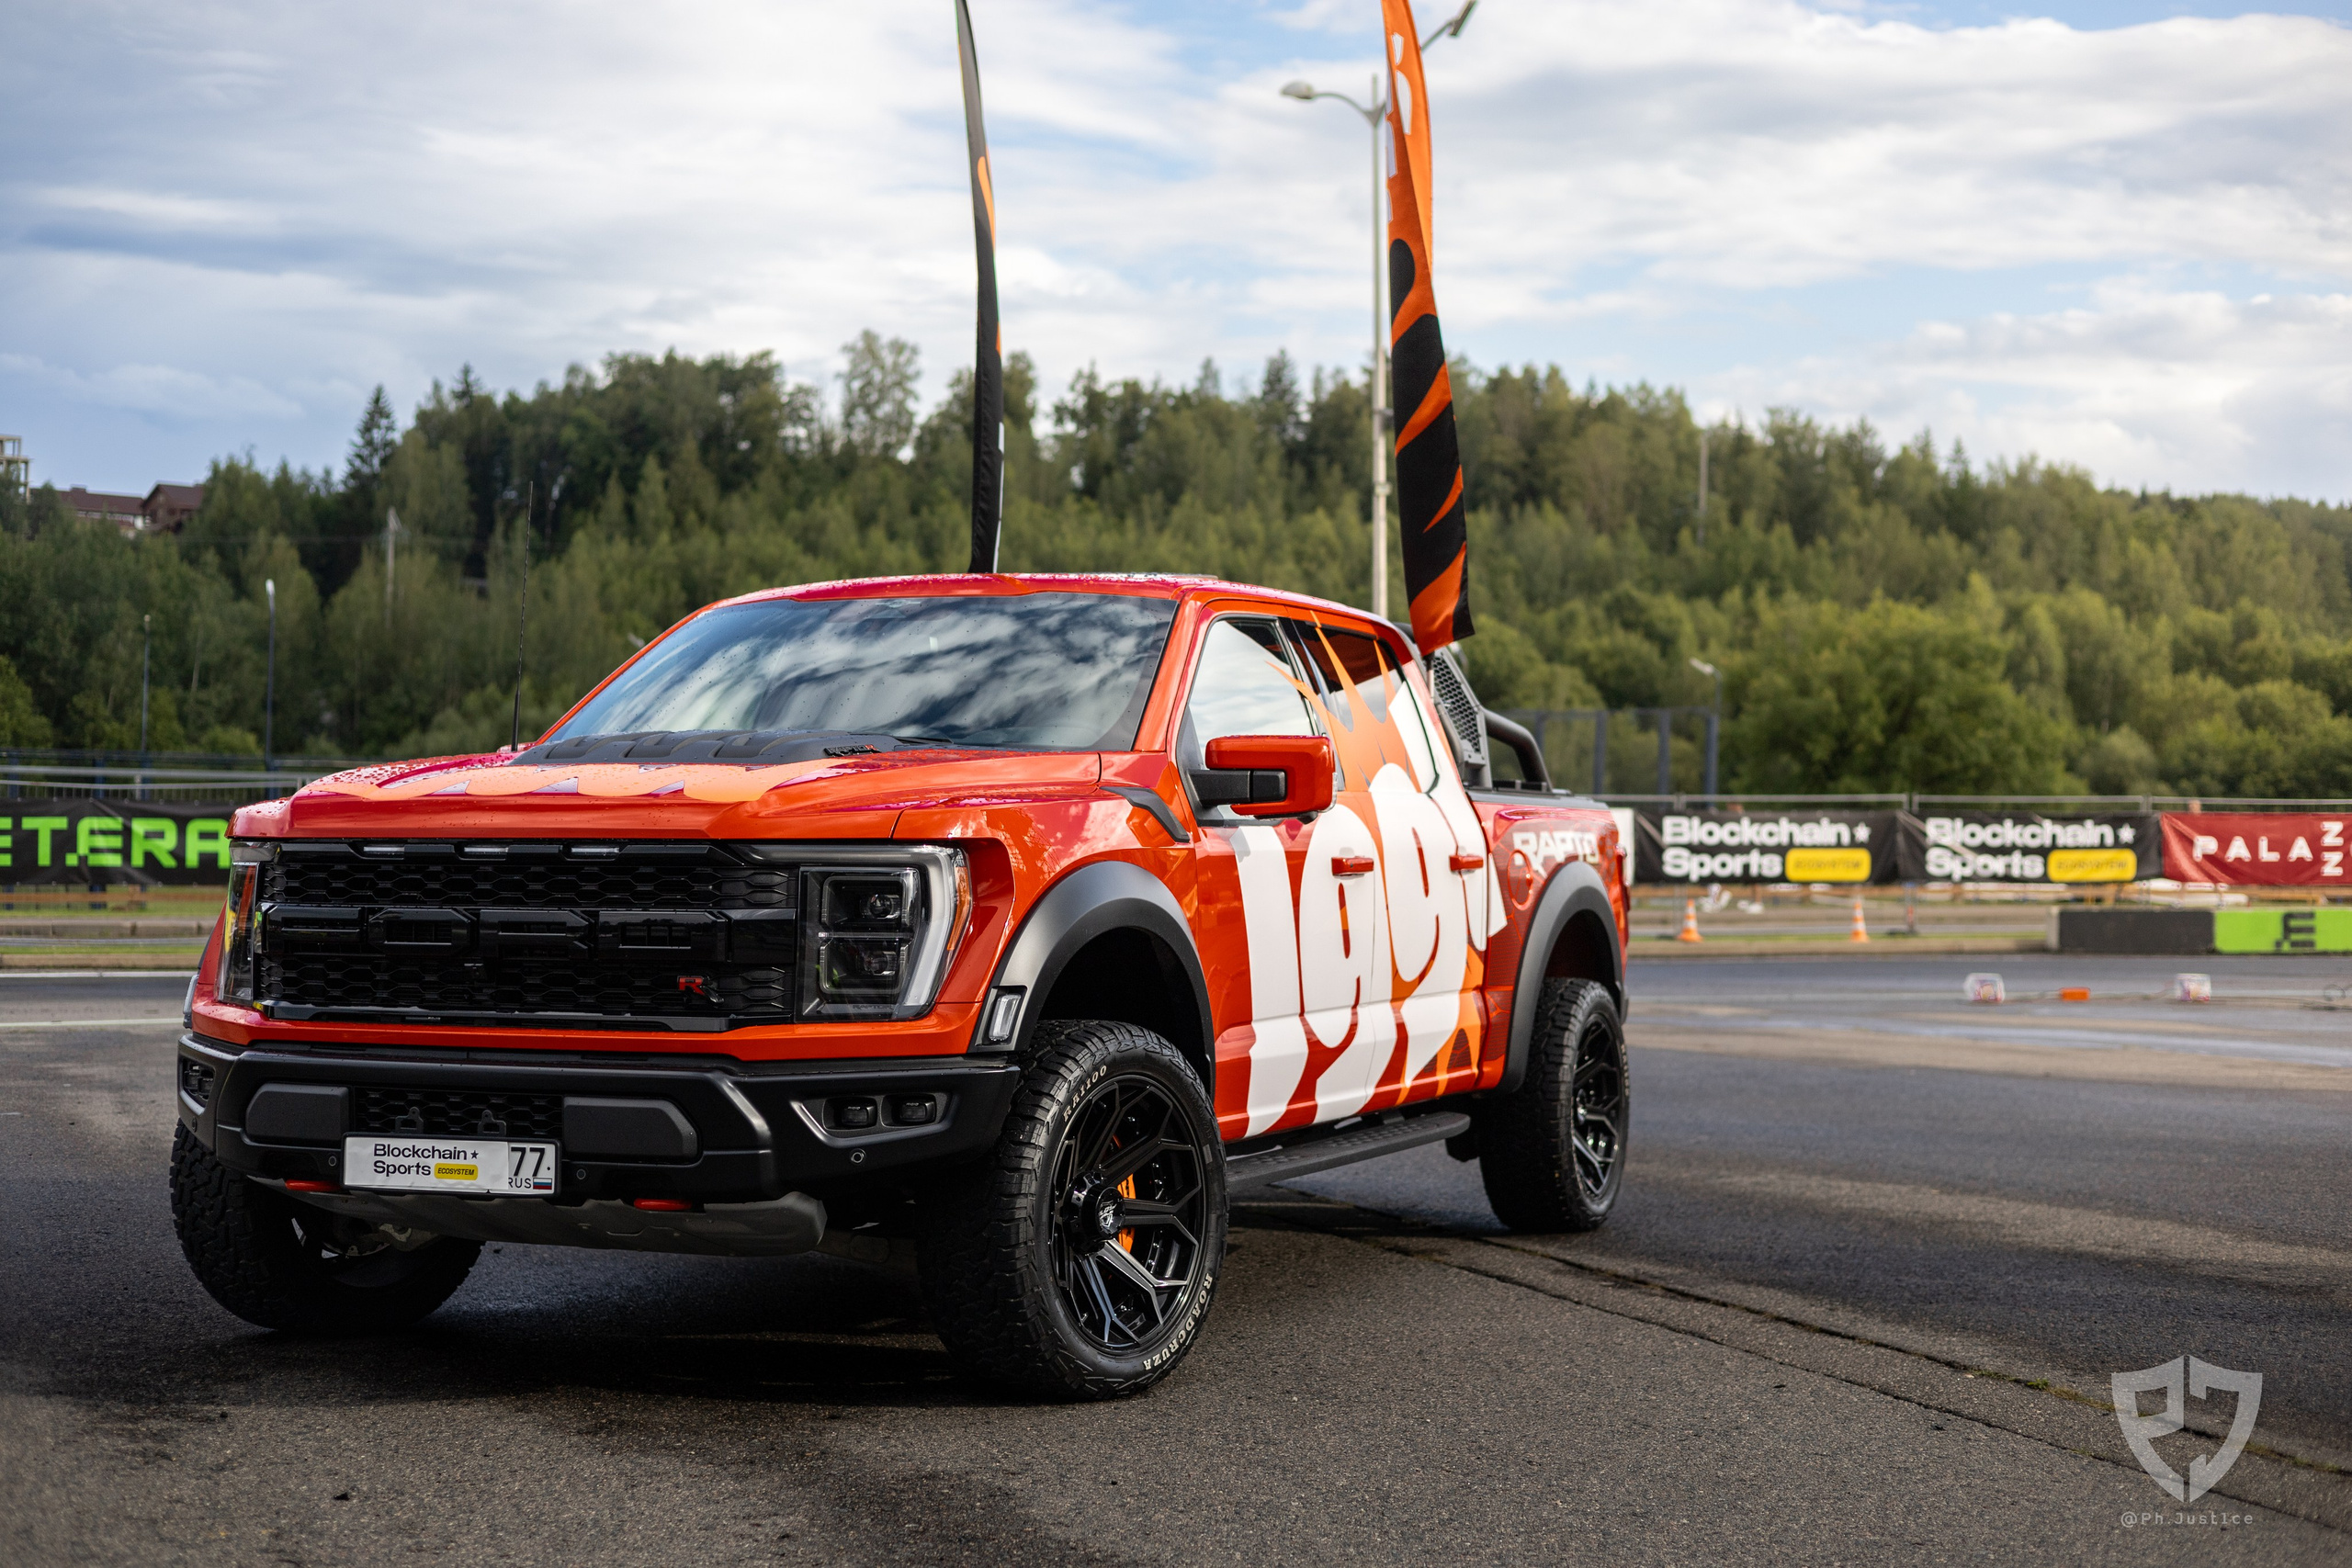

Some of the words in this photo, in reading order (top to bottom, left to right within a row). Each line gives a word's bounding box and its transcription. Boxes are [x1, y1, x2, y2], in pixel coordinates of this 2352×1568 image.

[1662, 816, 1851, 846] Blockchain
[1925, 818, 2115, 847] Blockchain
[1662, 846, 1783, 882] Sports
[1925, 846, 2045, 882] Sports
[373, 1144, 467, 1160] Blockchain
[510, 1146, 546, 1177] 77
[373, 1160, 431, 1177] Sports
[437, 1168, 475, 1176] ECOSYSTEM
[1143, 1273, 1213, 1371] ROADCRUZA
